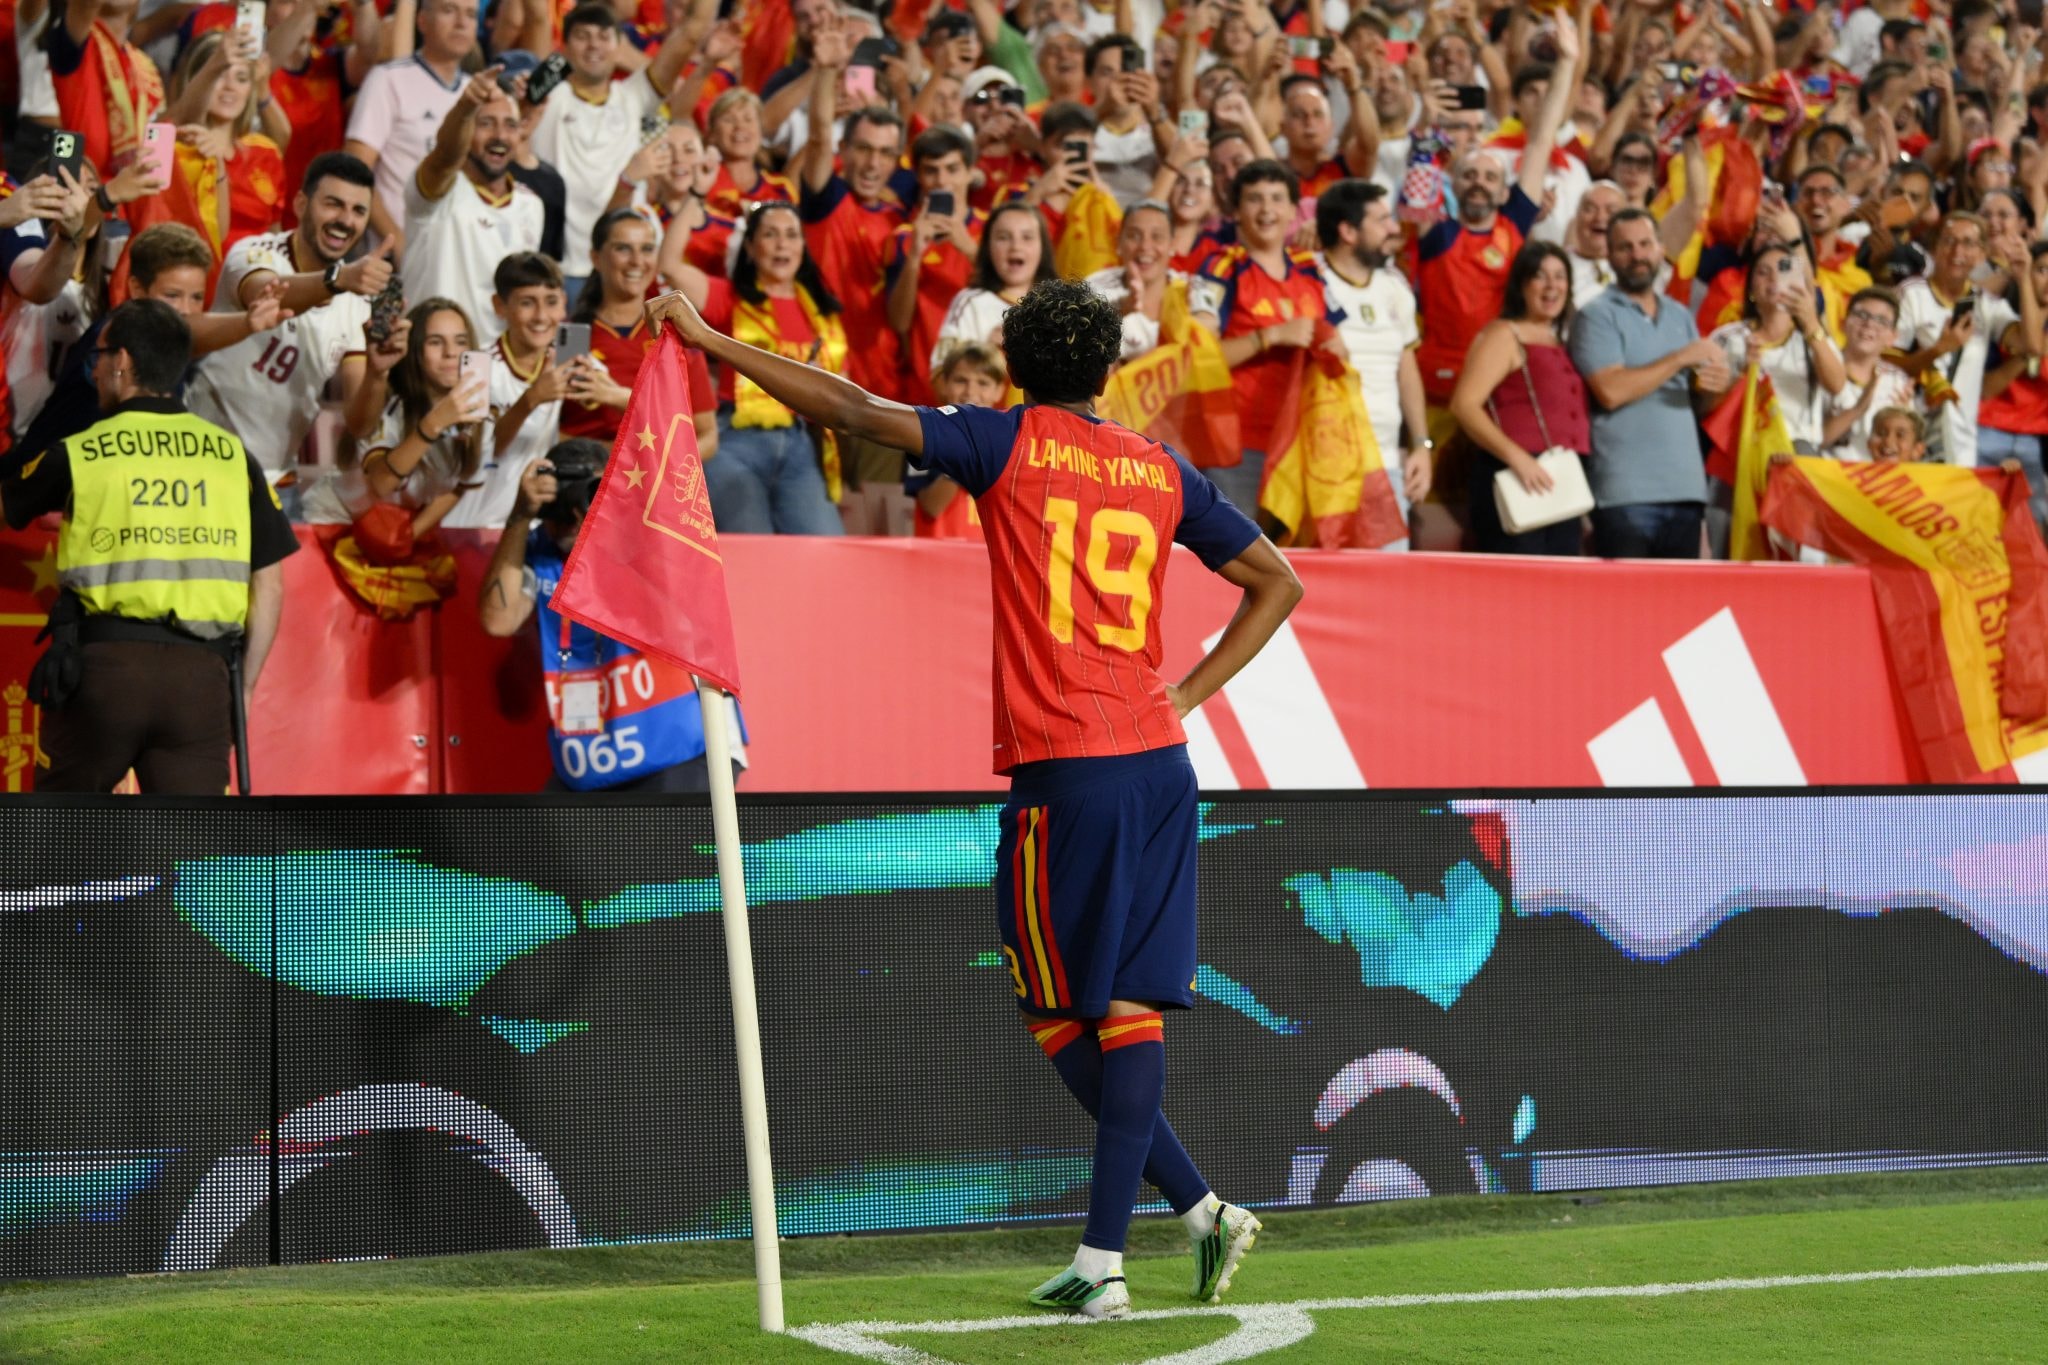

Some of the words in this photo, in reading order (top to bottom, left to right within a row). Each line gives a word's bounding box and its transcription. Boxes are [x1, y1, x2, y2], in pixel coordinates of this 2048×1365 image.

[252, 335, 300, 385] 19
[81, 430, 235, 462] SEGURIDAD
[1028, 437, 1102, 483] LAMINE
[1103, 456, 1175, 493] YAMAL
[131, 478, 207, 507] 2201
[1840, 462, 1960, 541] AMOS
[120, 526, 237, 547] PROSEGUR
[1045, 496, 1158, 653] 19
[561, 724, 646, 779] 065
